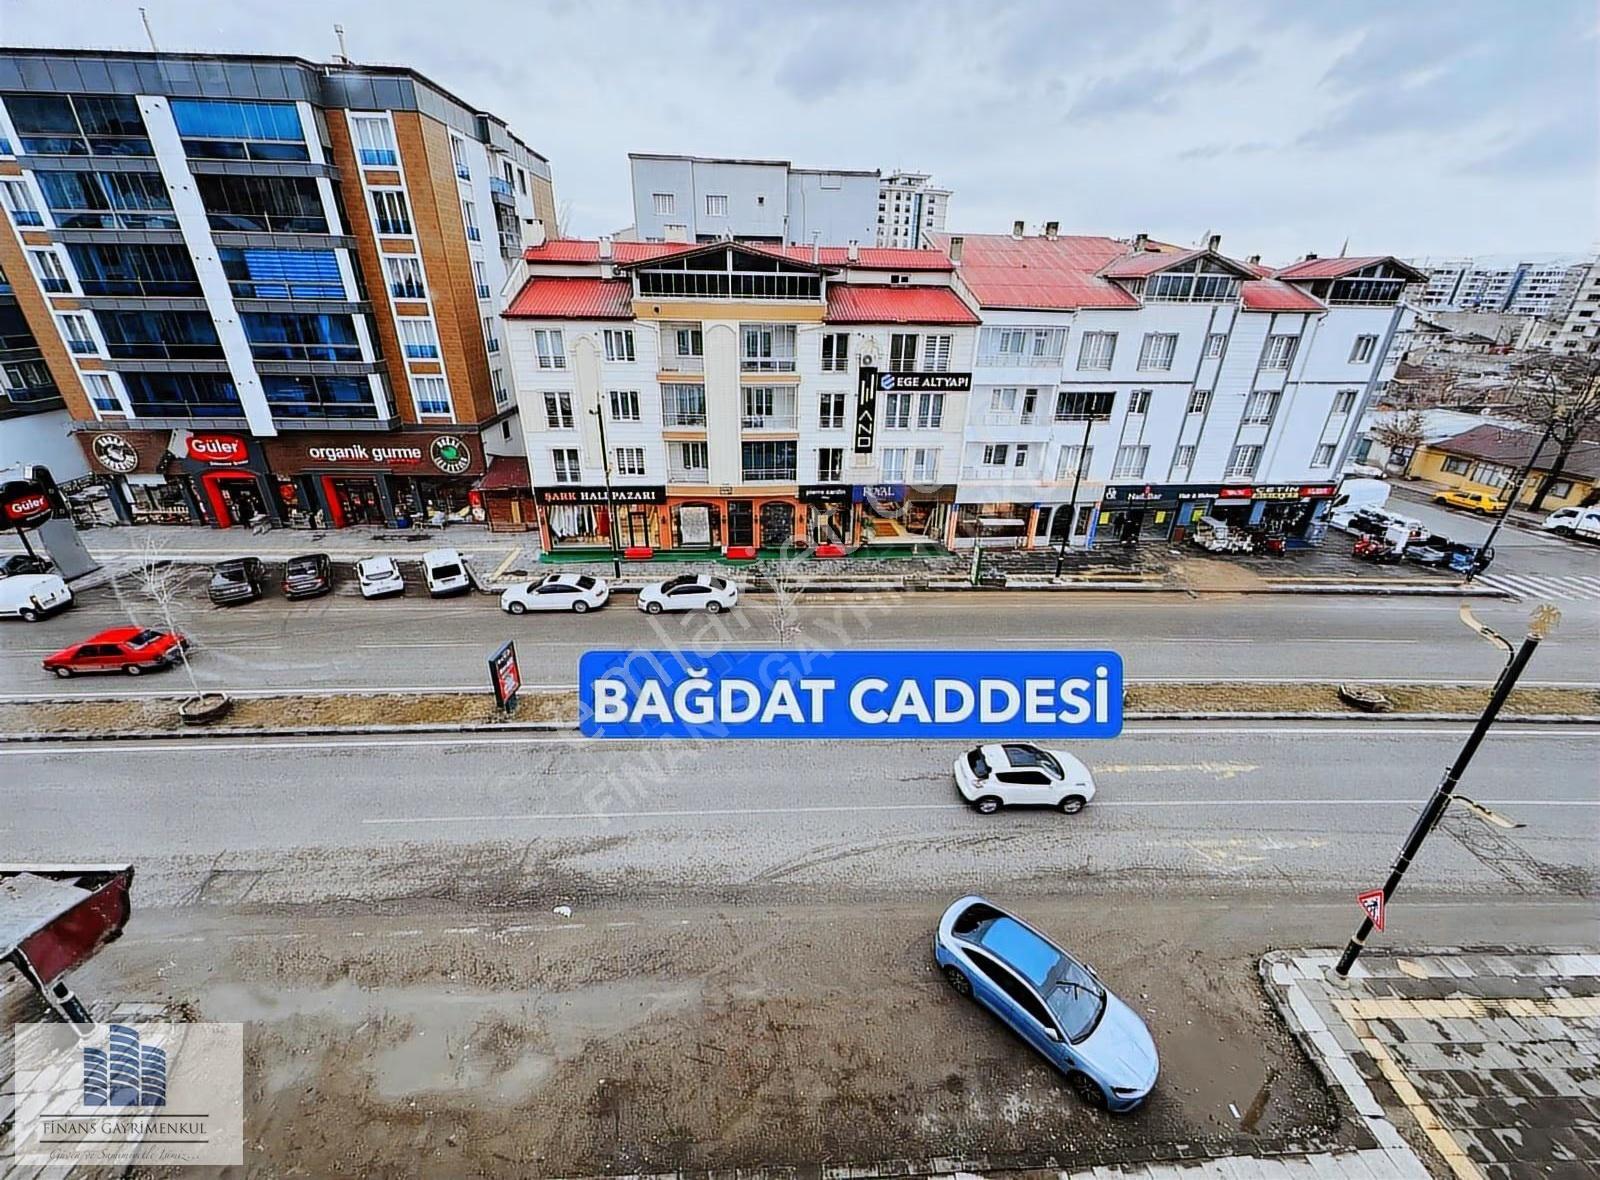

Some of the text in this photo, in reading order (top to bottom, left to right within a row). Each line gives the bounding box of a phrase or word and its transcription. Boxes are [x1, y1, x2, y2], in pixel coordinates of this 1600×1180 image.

[896, 377, 969, 387] EGE ALTYAPI
[191, 439, 238, 454] Güler
[309, 444, 369, 461] organik
[372, 447, 422, 461] gurme
[612, 491, 656, 500] PAZARI
[12, 497, 45, 513] Güler
